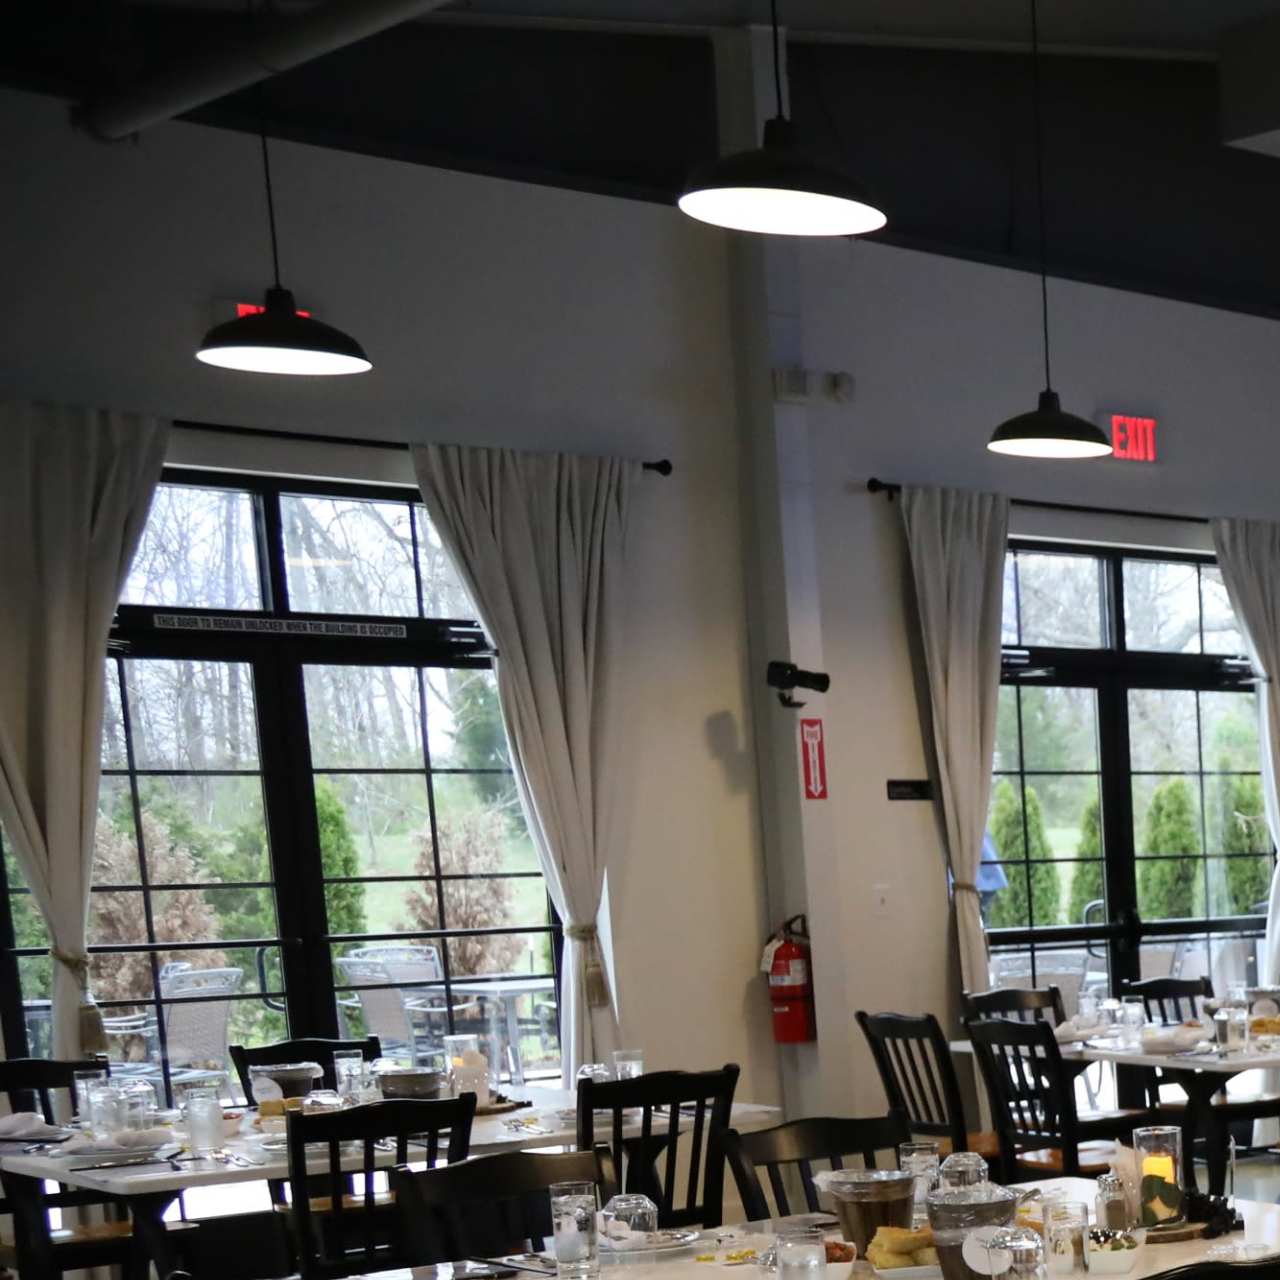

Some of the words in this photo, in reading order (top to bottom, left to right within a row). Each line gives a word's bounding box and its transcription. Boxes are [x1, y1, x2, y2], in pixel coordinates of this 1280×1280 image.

[1112, 415, 1157, 462] EXIT
[157, 615, 176, 627] THIS
[177, 616, 198, 628] DOOR
[201, 617, 211, 628] TO
[213, 617, 243, 630] REMAIN
[245, 619, 283, 632] UNLOCKED
[286, 621, 307, 633] WHEN
[309, 622, 323, 633] THE
[325, 623, 358, 635] BUILDING
[360, 625, 367, 635] IS
[369, 625, 404, 636] OCCUPIED
